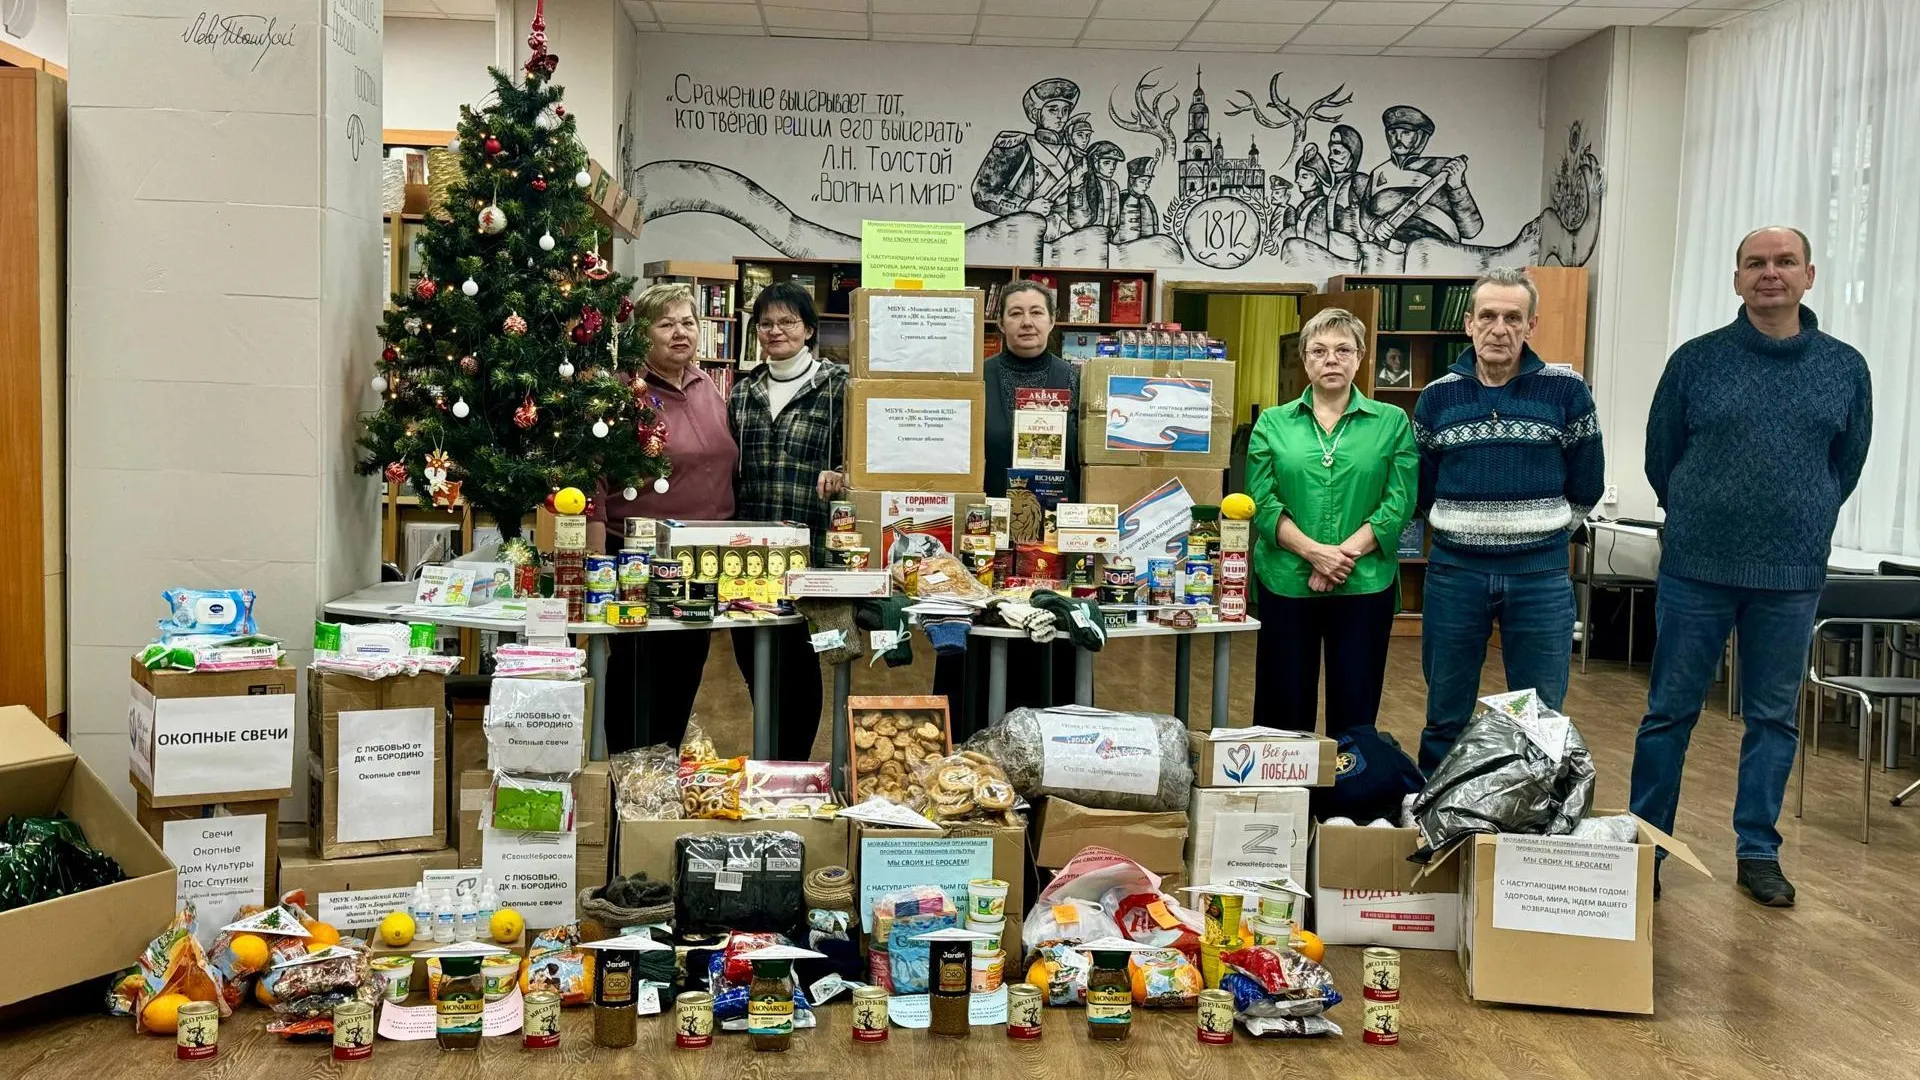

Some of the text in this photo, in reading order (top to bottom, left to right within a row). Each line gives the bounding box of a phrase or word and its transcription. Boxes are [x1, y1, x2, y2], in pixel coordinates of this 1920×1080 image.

[780, 89, 867, 114] выигрывает
[877, 93, 905, 117] тот,
[675, 108, 705, 131] кто
[775, 115, 833, 139] решил
[840, 118, 873, 141] его
[821, 145, 857, 171] Л.Н.
[1198, 210, 1251, 250] 1812
[905, 495, 948, 505] ГОРДИМСЯ!
[515, 712, 560, 720] ЛЮБОВЬЮ
[504, 721, 516, 729] ДК
[526, 720, 573, 729] БОРОДИНО
[158, 727, 288, 746] ОКОПНЫЕ СВЕЧИ
[508, 738, 544, 746] Окопные
[365, 743, 411, 753] ЛЮБОВЬЮ
[1262, 744, 1280, 759] Всё
[354, 755, 366, 763] ДК
[377, 750, 424, 762] БОРОДИНО
[358, 769, 421, 780] Окопные свечи
[1261, 763, 1309, 781] ПОБЕДЫ
[202, 829, 233, 839] Свечи
[1242, 824, 1279, 854] Z
[193, 845, 241, 857] Окопные
[178, 860, 254, 875] Дом Культуры
[770, 860, 798, 868] ТЕРМО
[1523, 856, 1537, 864] МЫ
[1538, 857, 1562, 866] СВОИХ
[1575, 861, 1613, 870] БРОСАЕМ!
[499, 883, 510, 891] ДК
[521, 882, 567, 890] БОРОДИНО
[1506, 880, 1566, 891] НАСТУПАЮЩИМ
[1568, 886, 1597, 894] НОВЫМ
[1599, 887, 1629, 896] ГОДОМ!
[1504, 892, 1627, 909] ЗДОРОВЬЯ, МИРА, ЖДЕМ ВАШЕГО
[1521, 905, 1610, 918] ВОЗВРАЩЕНИЯ ДОМОЙ!
[942, 951, 965, 959] Jardin
[605, 960, 630, 968] Jardin
